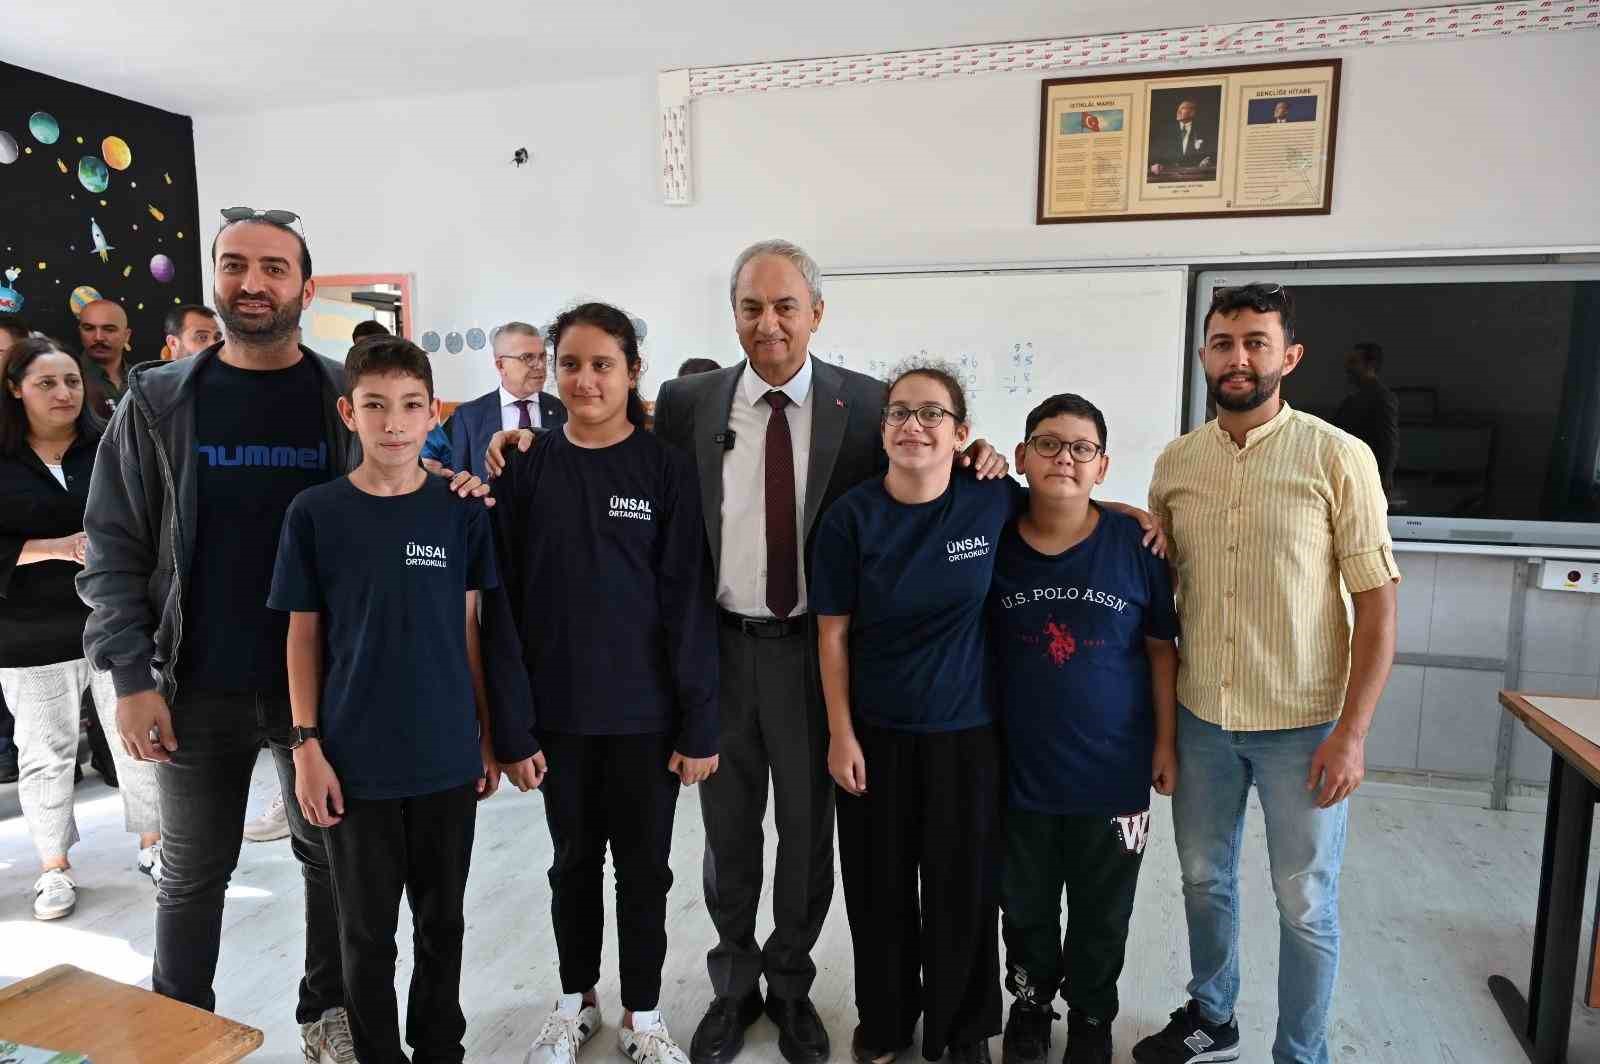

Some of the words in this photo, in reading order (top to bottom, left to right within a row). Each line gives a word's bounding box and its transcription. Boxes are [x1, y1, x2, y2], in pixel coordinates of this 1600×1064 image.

[609, 495, 651, 512] ÜNSAL
[608, 510, 651, 520] ORTAOKULU
[406, 541, 447, 559] ÜNSAL
[946, 535, 990, 554] ÜNSAL
[405, 558, 447, 568] ORTAOKULU
[1002, 592, 1031, 609] U.S.
[1033, 588, 1079, 601] POLO
